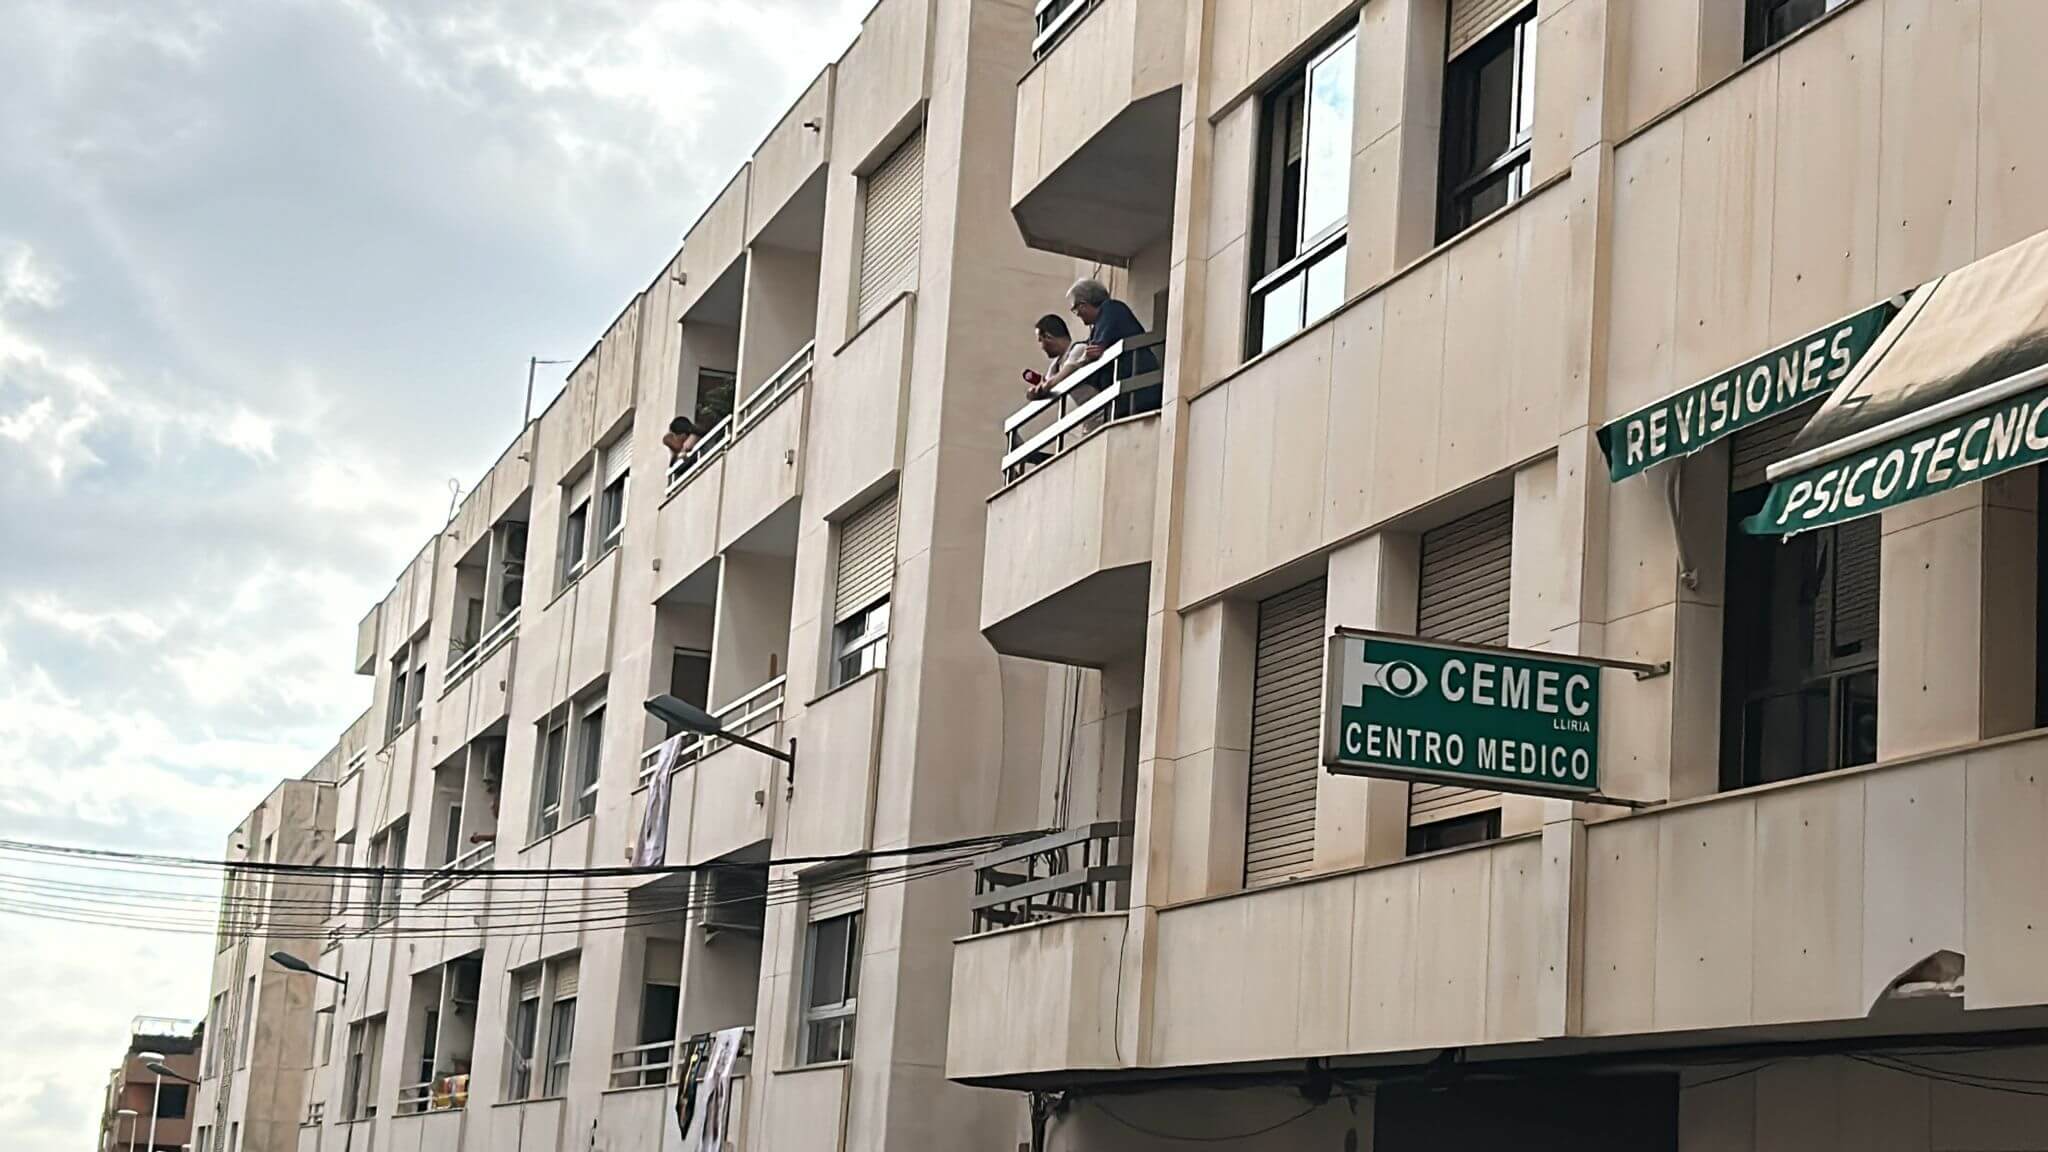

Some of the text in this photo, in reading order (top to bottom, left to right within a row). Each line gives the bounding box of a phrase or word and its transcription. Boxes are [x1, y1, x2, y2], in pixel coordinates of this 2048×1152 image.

[1626, 326, 1853, 466] REVISIONES
[1440, 659, 1590, 716] CEMEC
[1346, 722, 1589, 780] CENTRO MEDICO
[1553, 718, 1590, 733] LLIRIA
